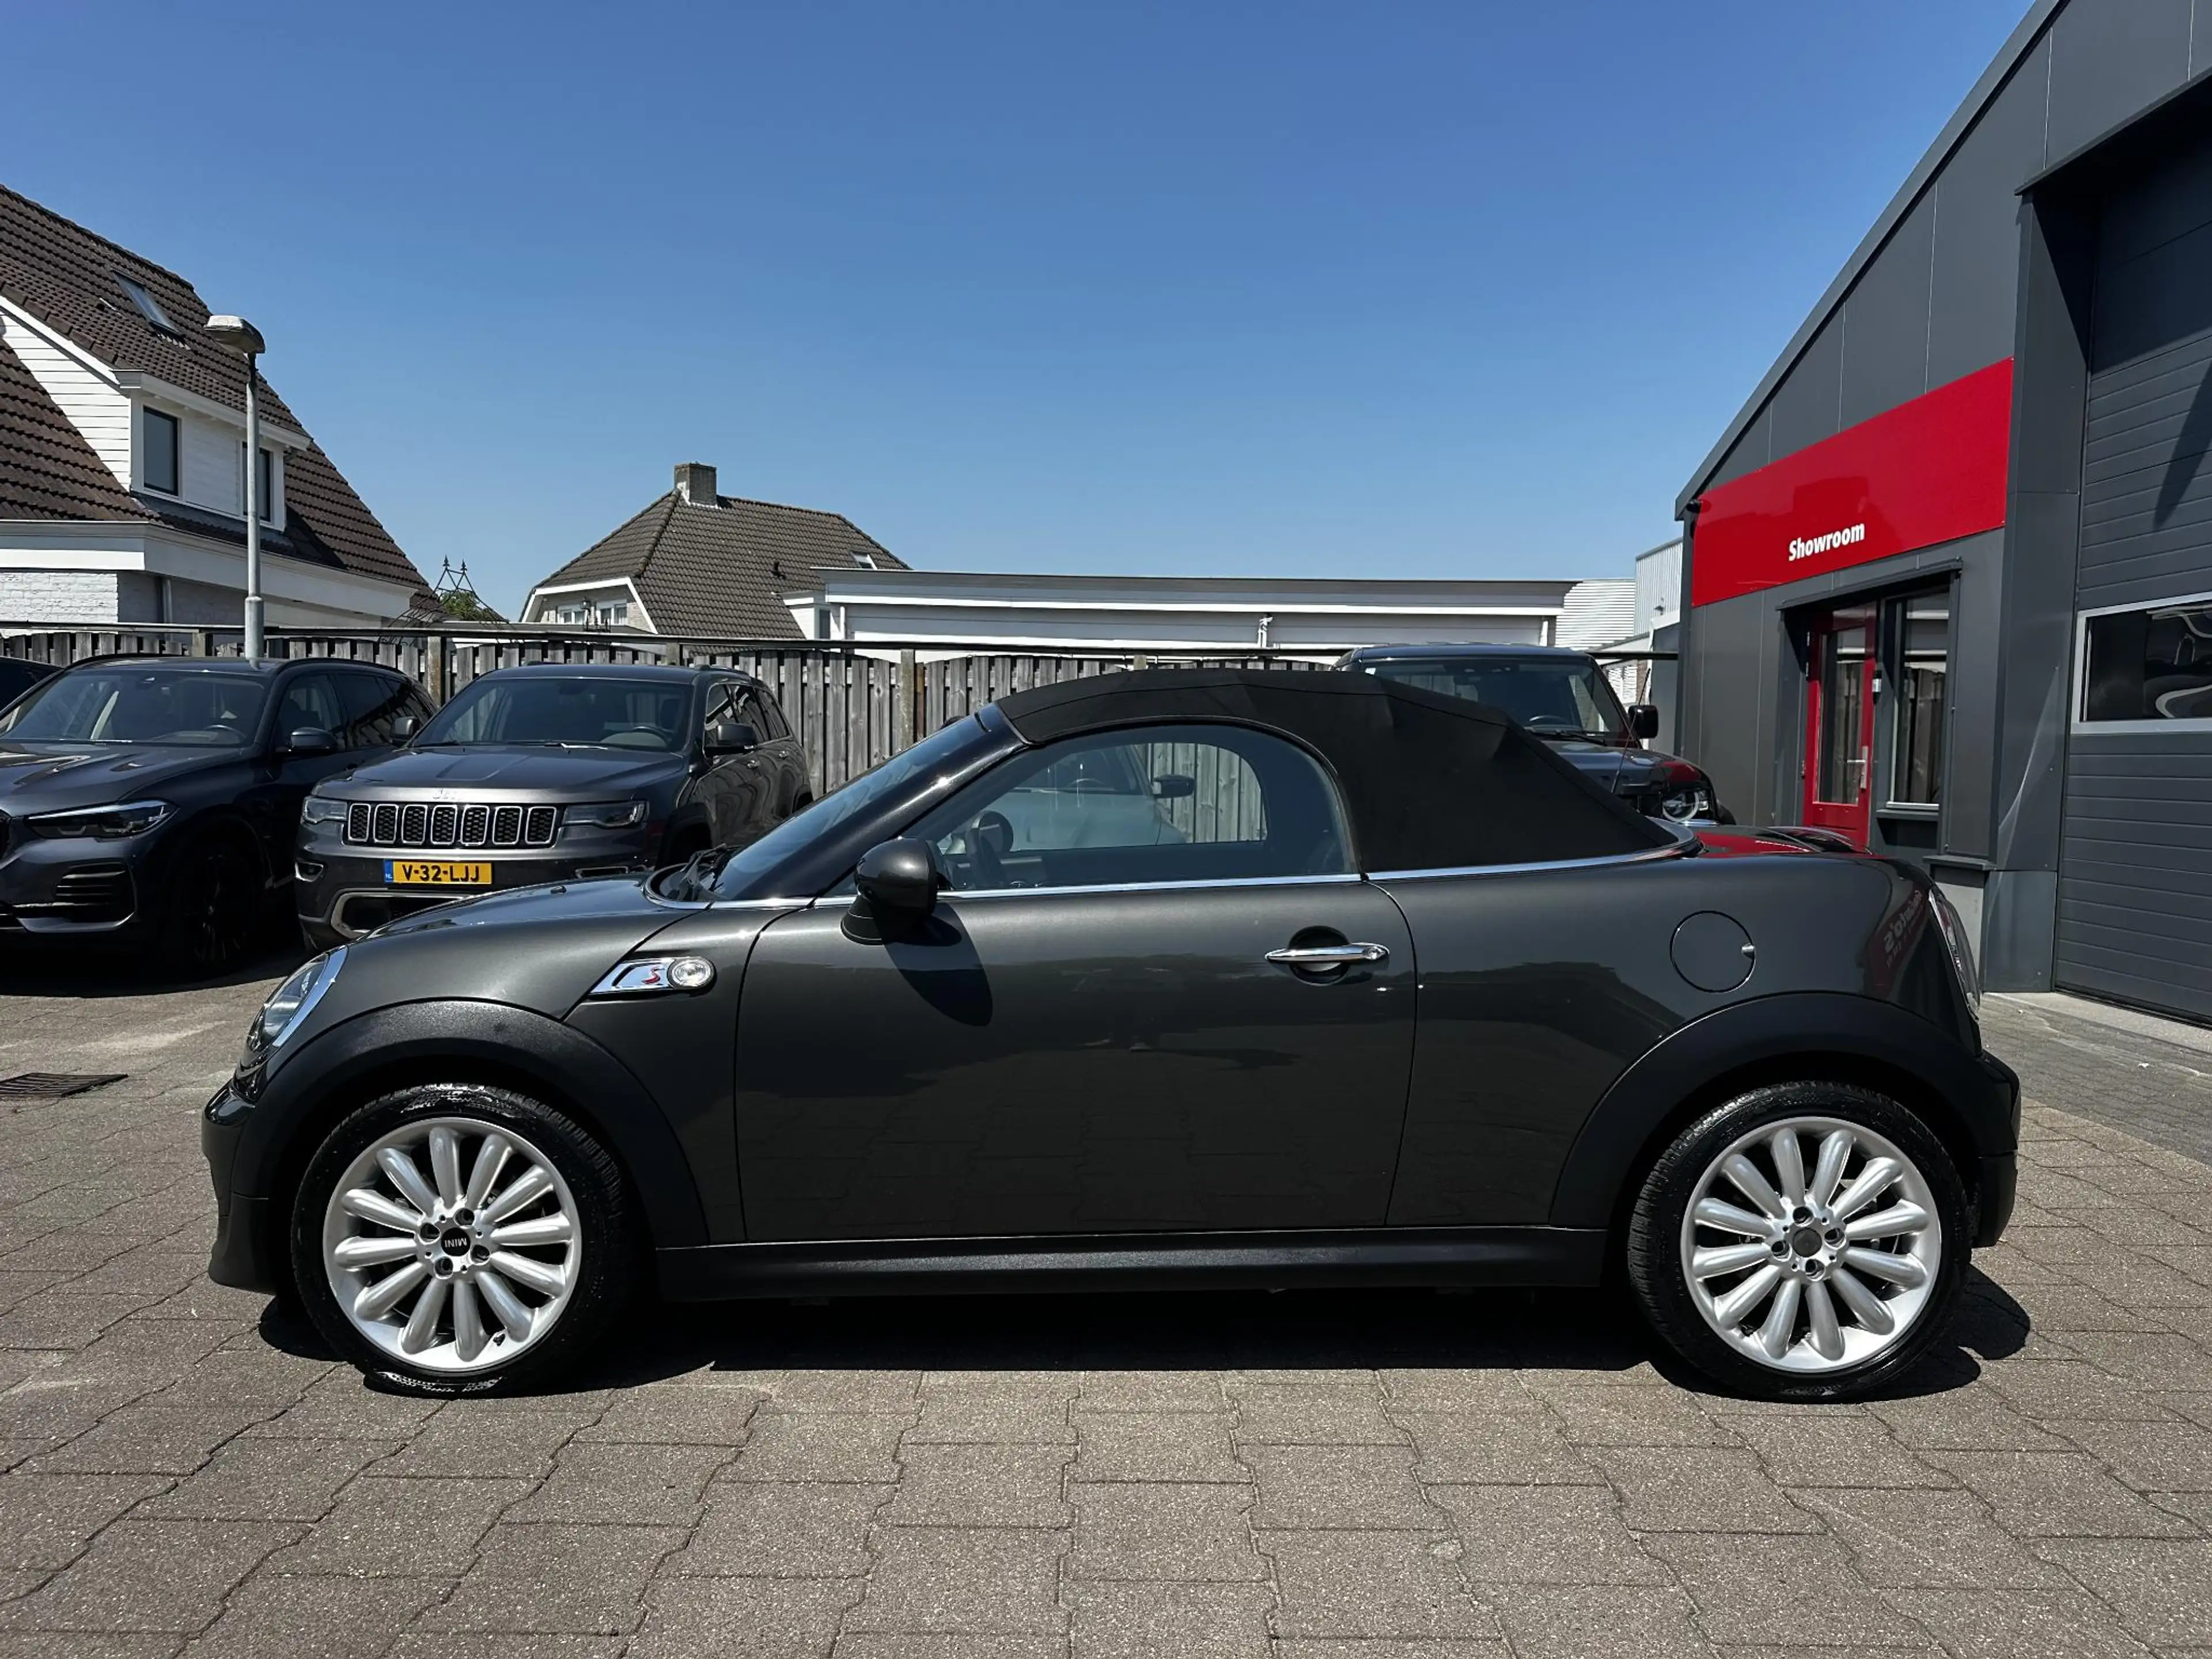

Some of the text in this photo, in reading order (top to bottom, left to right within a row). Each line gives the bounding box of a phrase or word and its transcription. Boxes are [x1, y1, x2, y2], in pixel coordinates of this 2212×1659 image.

[1789, 523, 1865, 562] Showroom
[402, 864, 479, 882] V-32-LJJ
[641, 967, 665, 984] S
[444, 1237, 468, 1248] MINI
